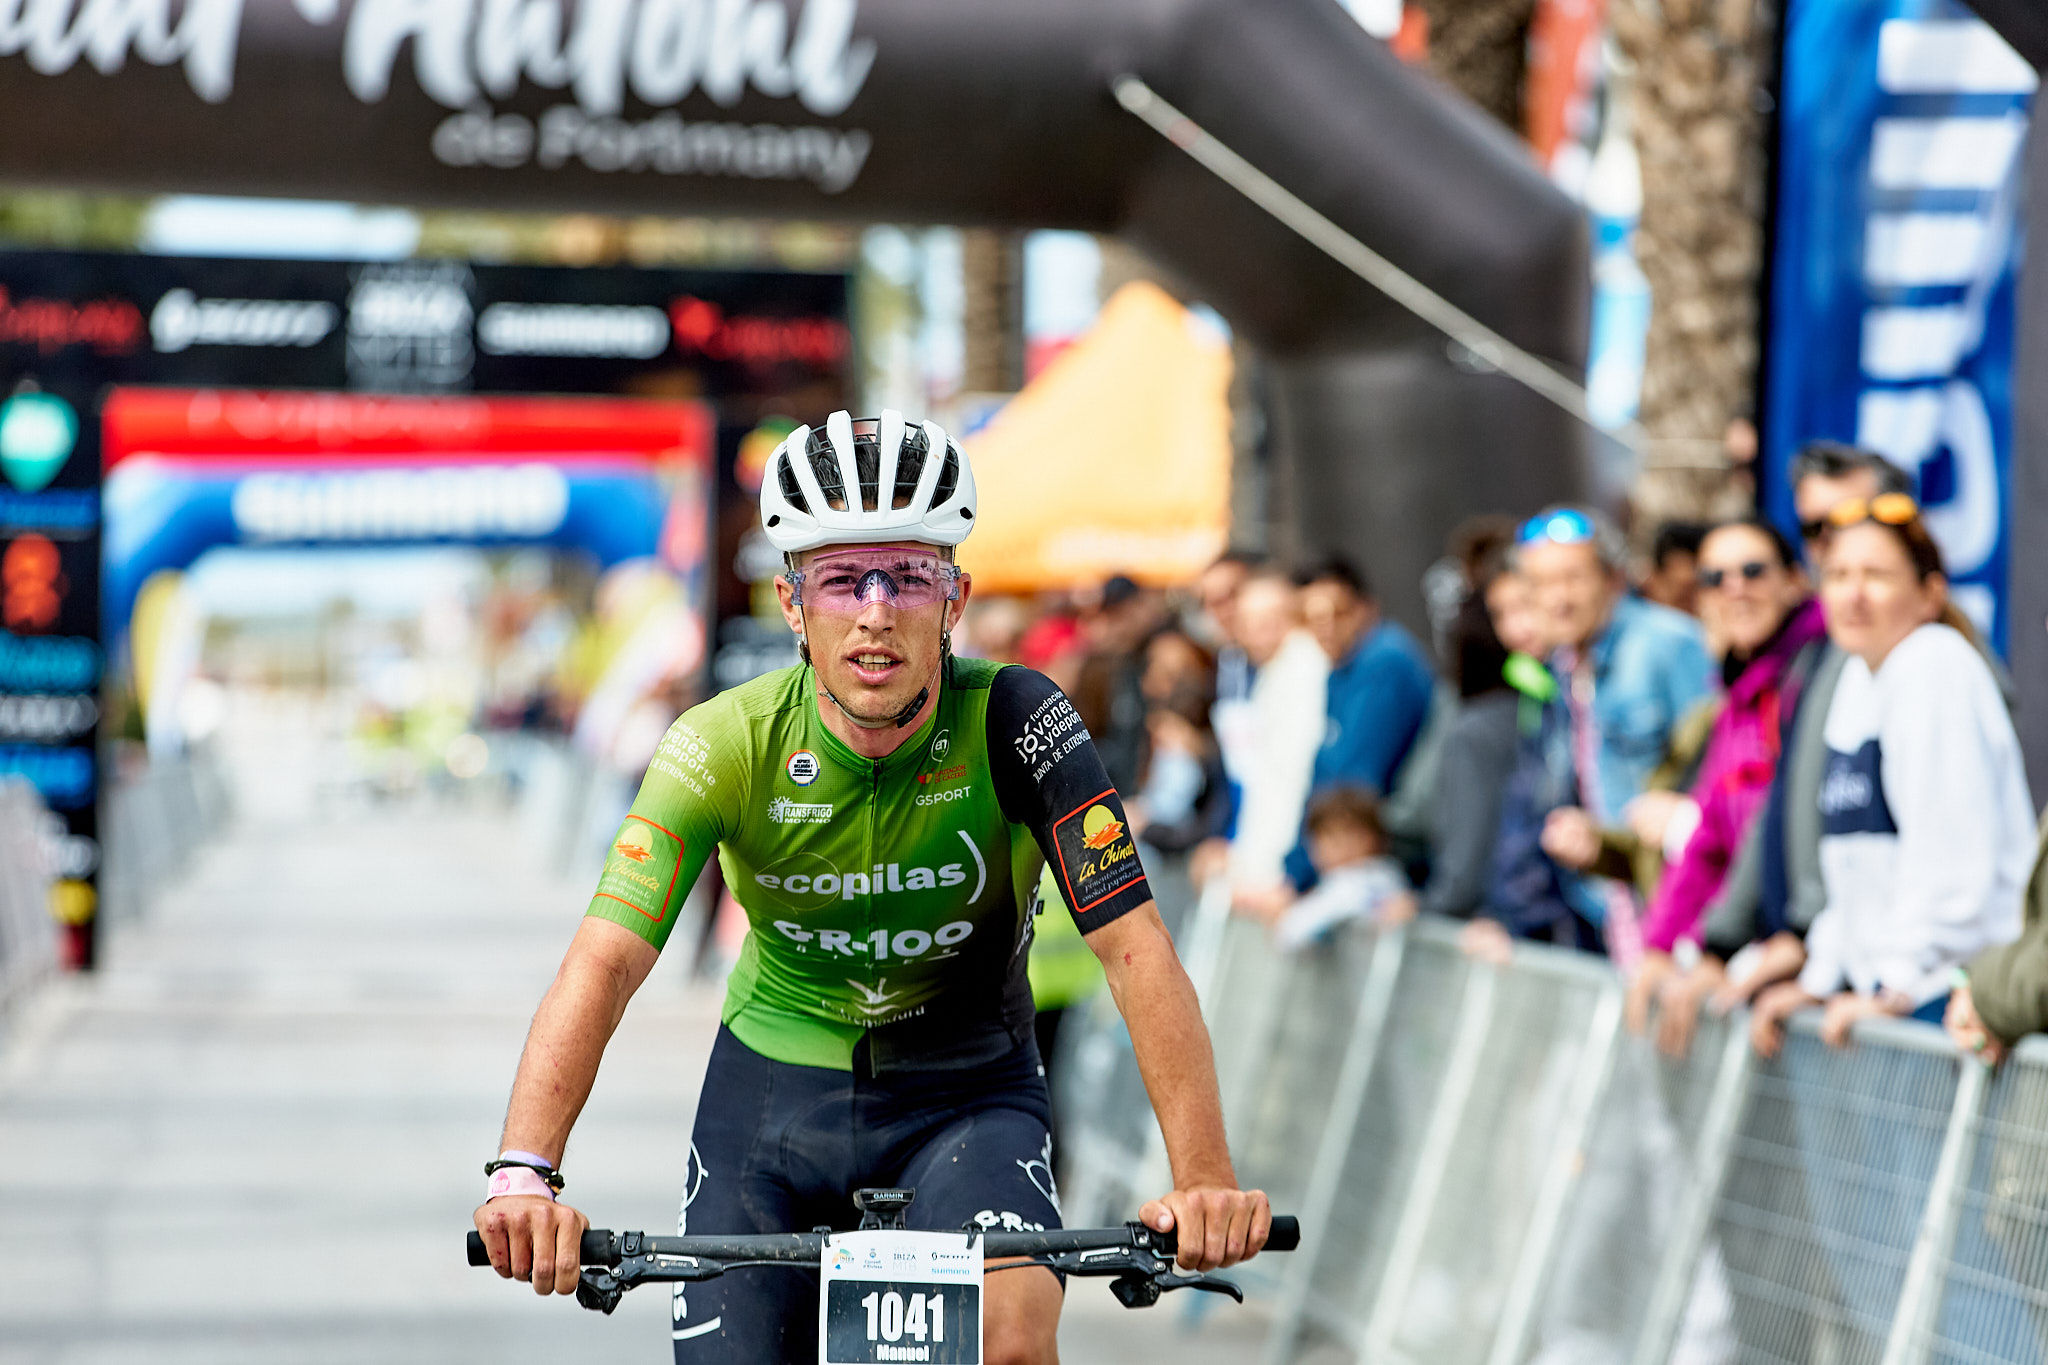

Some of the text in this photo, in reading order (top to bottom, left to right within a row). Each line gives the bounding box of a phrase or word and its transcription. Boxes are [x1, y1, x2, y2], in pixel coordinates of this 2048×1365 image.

[431, 104, 873, 194] de Portmany
[1033, 760, 1053, 784] JUNTA
[1052, 747, 1064, 763] DE
[915, 785, 971, 806] GSPORT
[754, 862, 968, 901] ecopilas
[1079, 861, 1097, 883] La
[773, 920, 974, 961] GR-100
[873, 1192, 904, 1200] GARMIN
[893, 1253, 916, 1261] IBIZA
[861, 1291, 944, 1342] 1041
[876, 1344, 930, 1362] Manuel
